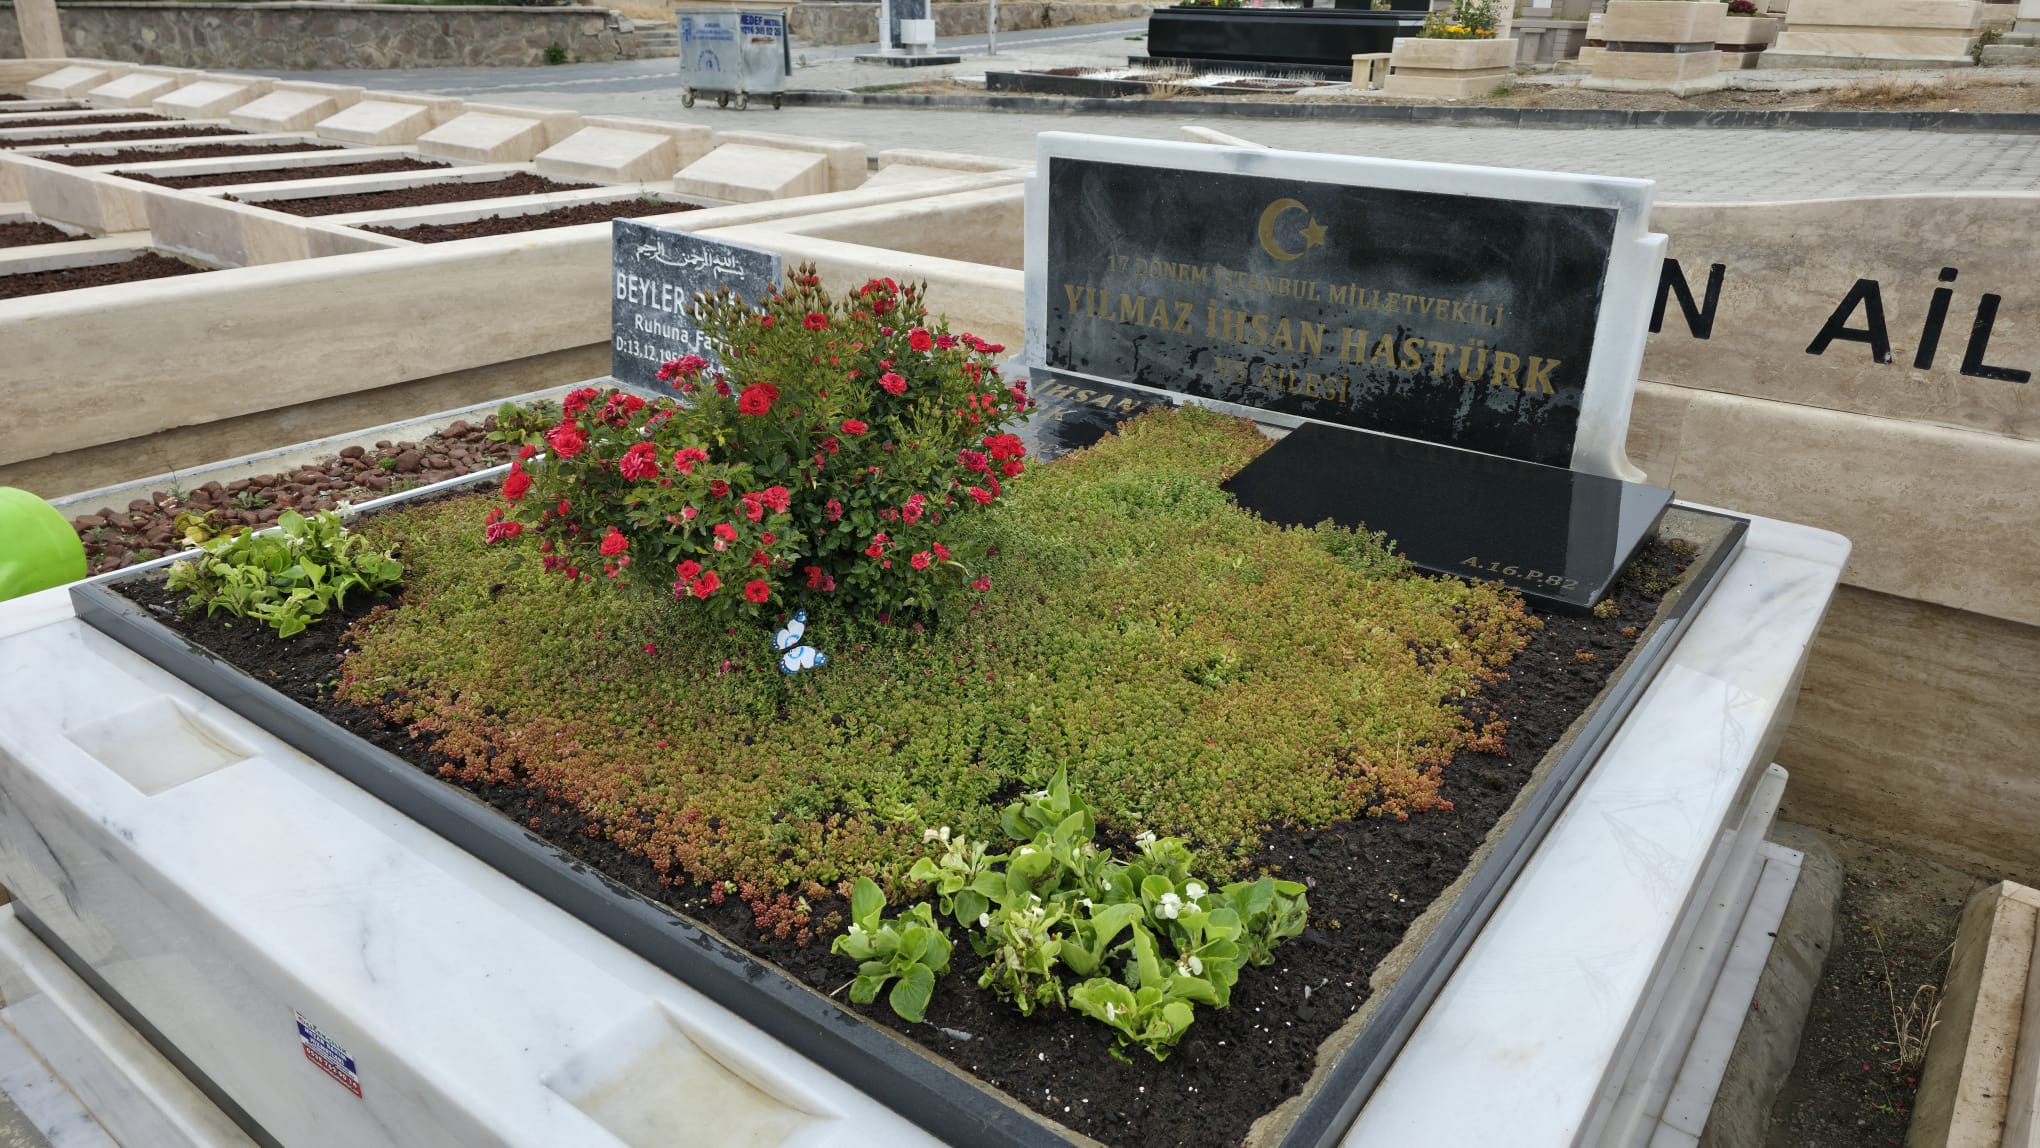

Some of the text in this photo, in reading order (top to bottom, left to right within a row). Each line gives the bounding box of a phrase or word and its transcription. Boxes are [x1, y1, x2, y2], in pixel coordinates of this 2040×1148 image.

[616, 273, 686, 317] BEYLER
[1215, 262, 1320, 301] İSTANBUL
[1329, 283, 1504, 329] MİLLETVEKİLİ
[634, 313, 689, 344] Ruhuna
[1064, 284, 1562, 395] YILMAZ İHSAN HASTÜRK
[1215, 356, 1349, 403] VE AİLESİ
